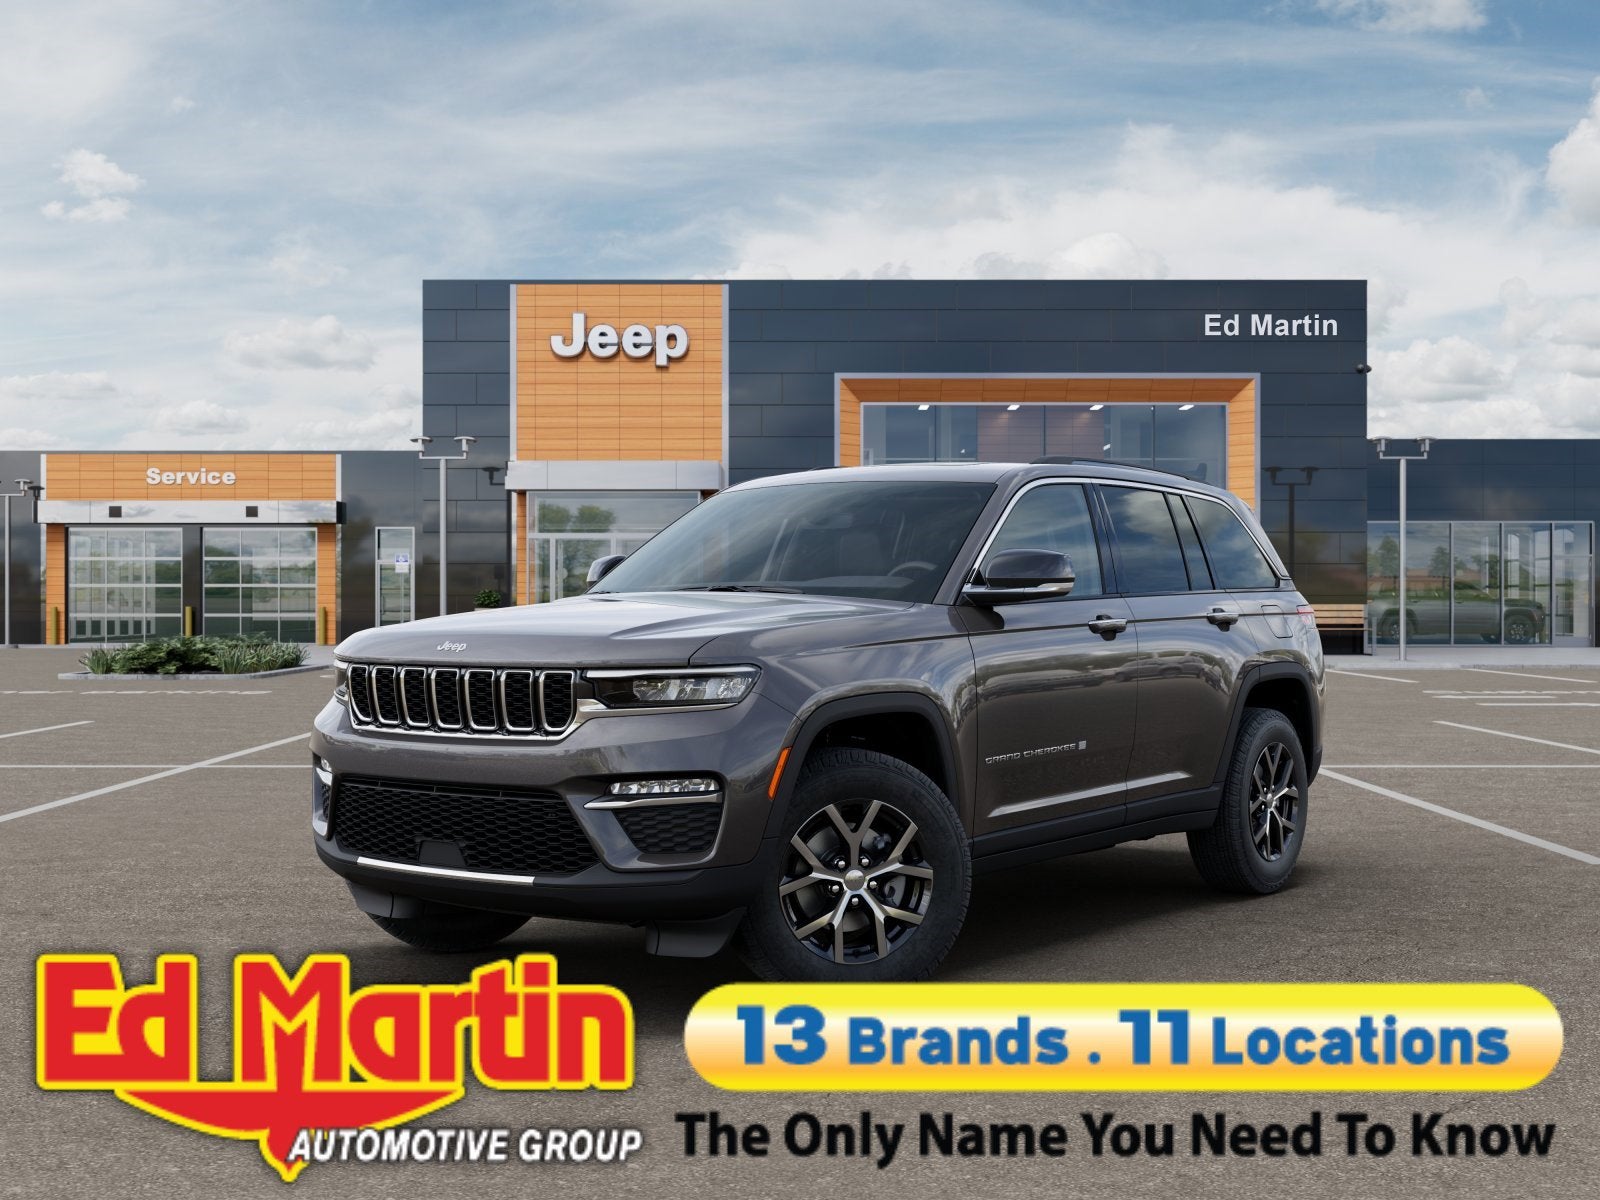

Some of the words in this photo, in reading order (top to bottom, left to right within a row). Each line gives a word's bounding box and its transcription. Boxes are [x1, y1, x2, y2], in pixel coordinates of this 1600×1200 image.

[1204, 313, 1240, 337] Ed
[1250, 313, 1338, 337] Martin
[550, 312, 690, 368] Jeep
[145, 467, 237, 486] Service
[436, 640, 467, 653] Jeep
[985, 752, 1021, 764] GRAND
[1023, 743, 1076, 758] CHEROKEE
